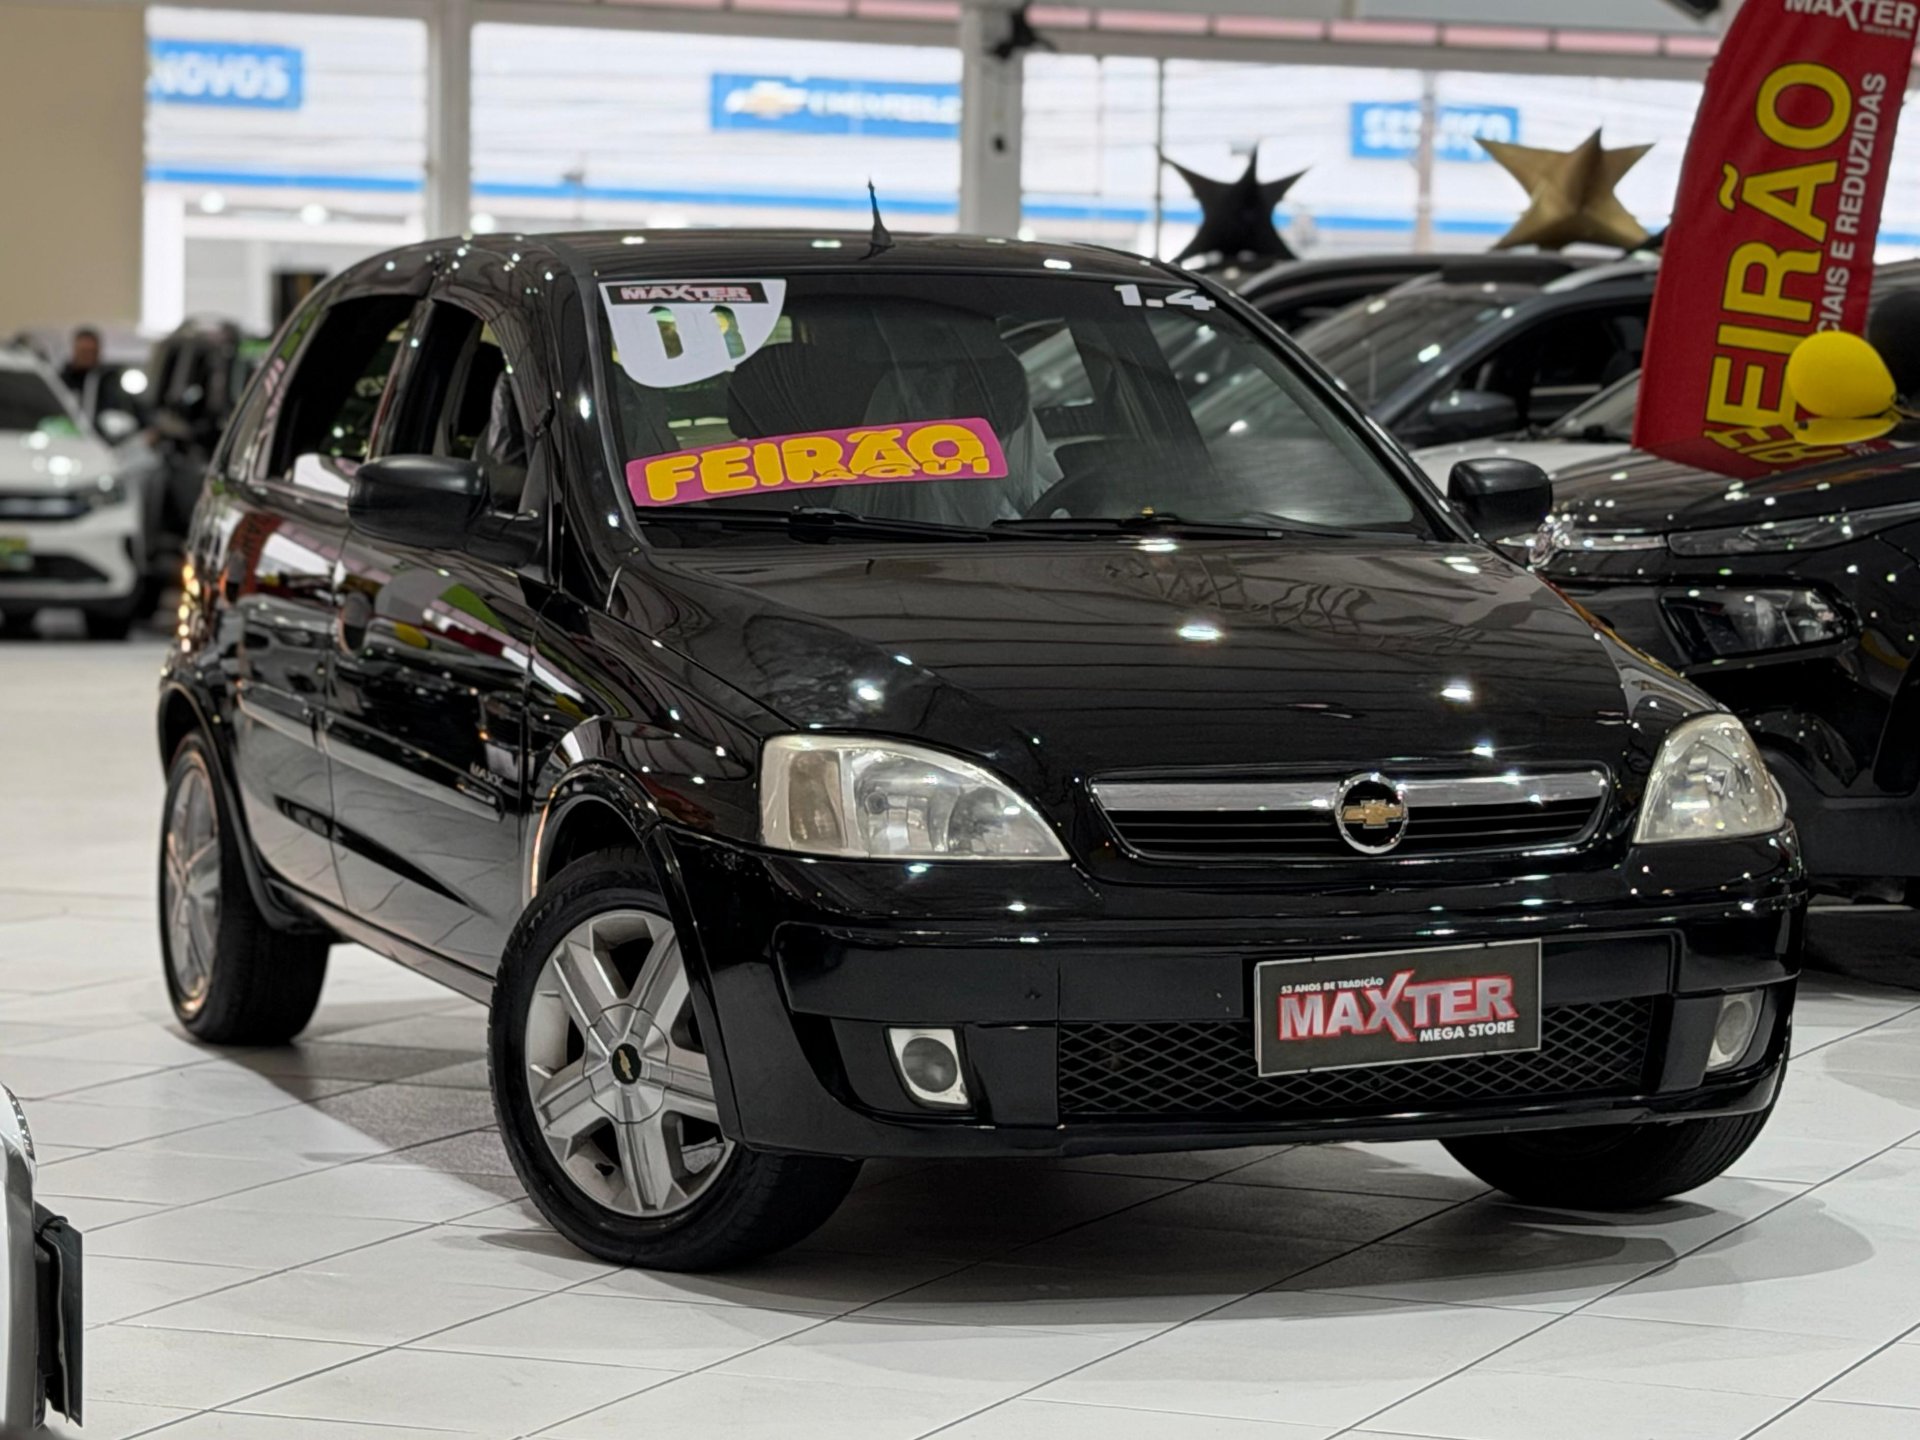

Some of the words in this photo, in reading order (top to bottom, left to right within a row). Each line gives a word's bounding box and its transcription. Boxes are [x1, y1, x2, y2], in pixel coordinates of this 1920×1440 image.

[1835, 73, 1887, 235] REDUZIDAS
[1831, 240, 1854, 261] E
[620, 284, 753, 302] MAXTER
[1114, 284, 1216, 311] 1.4
[645, 424, 986, 501] FEIRÃO
[1294, 982, 1321, 993] ANOS
[1323, 981, 1335, 991] DE
[1337, 976, 1384, 989] TRADIÇÃO
[1278, 969, 1519, 1042] MAXTER
[1419, 1026, 1465, 1042] MEGA
[1468, 1020, 1516, 1037] STORE
